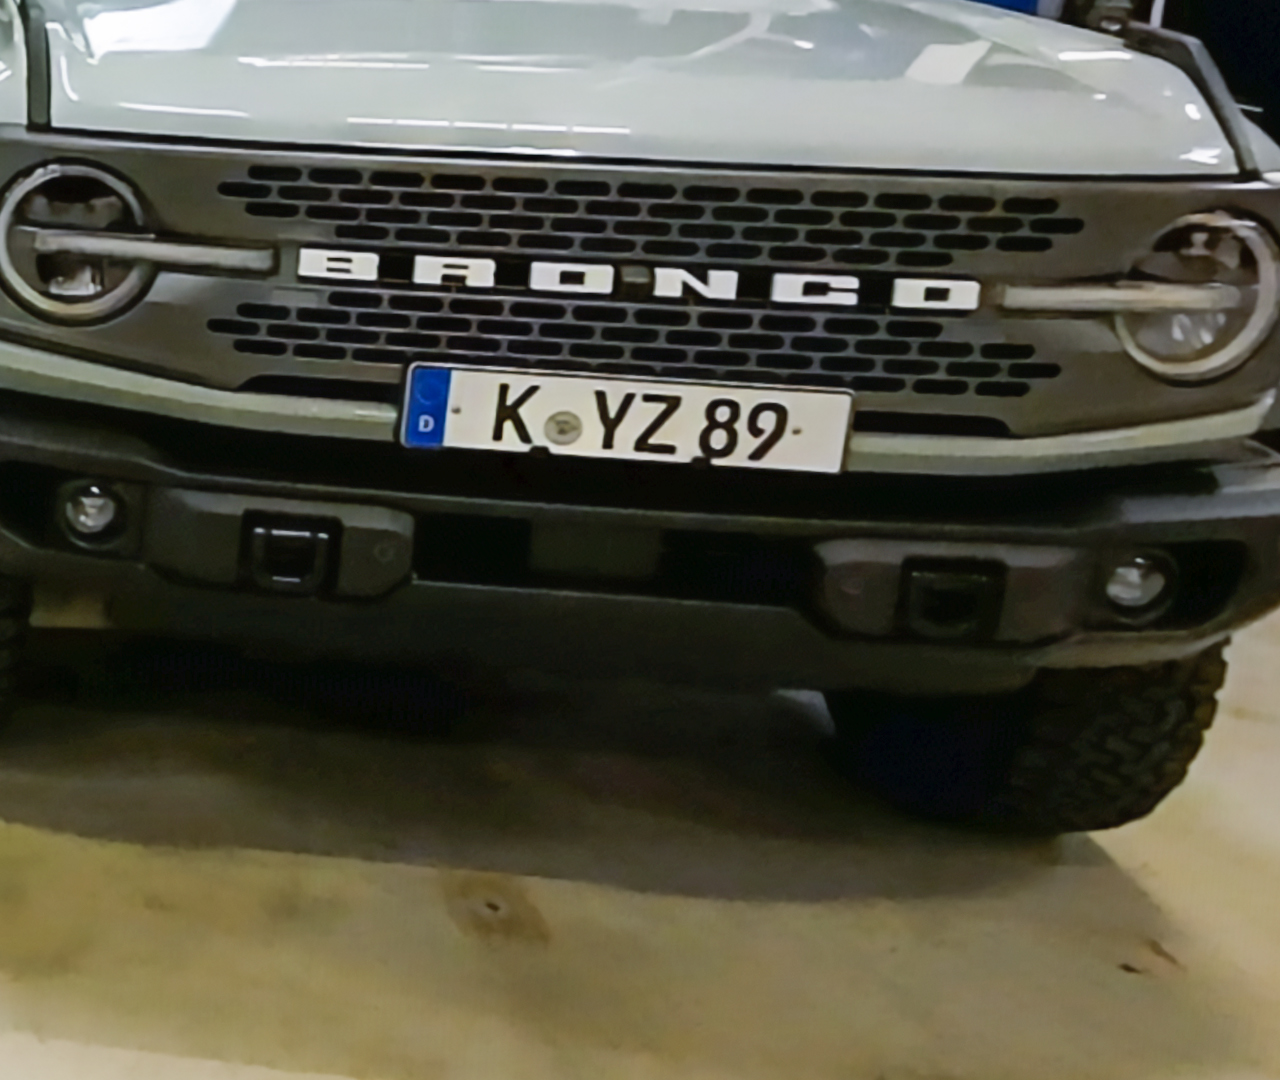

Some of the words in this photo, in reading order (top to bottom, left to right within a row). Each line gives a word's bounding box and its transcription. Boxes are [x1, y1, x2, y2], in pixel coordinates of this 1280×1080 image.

[297, 247, 982, 311] BRONCO
[491, 382, 541, 445] K
[593, 390, 683, 455] YZ
[698, 398, 790, 462] 89
